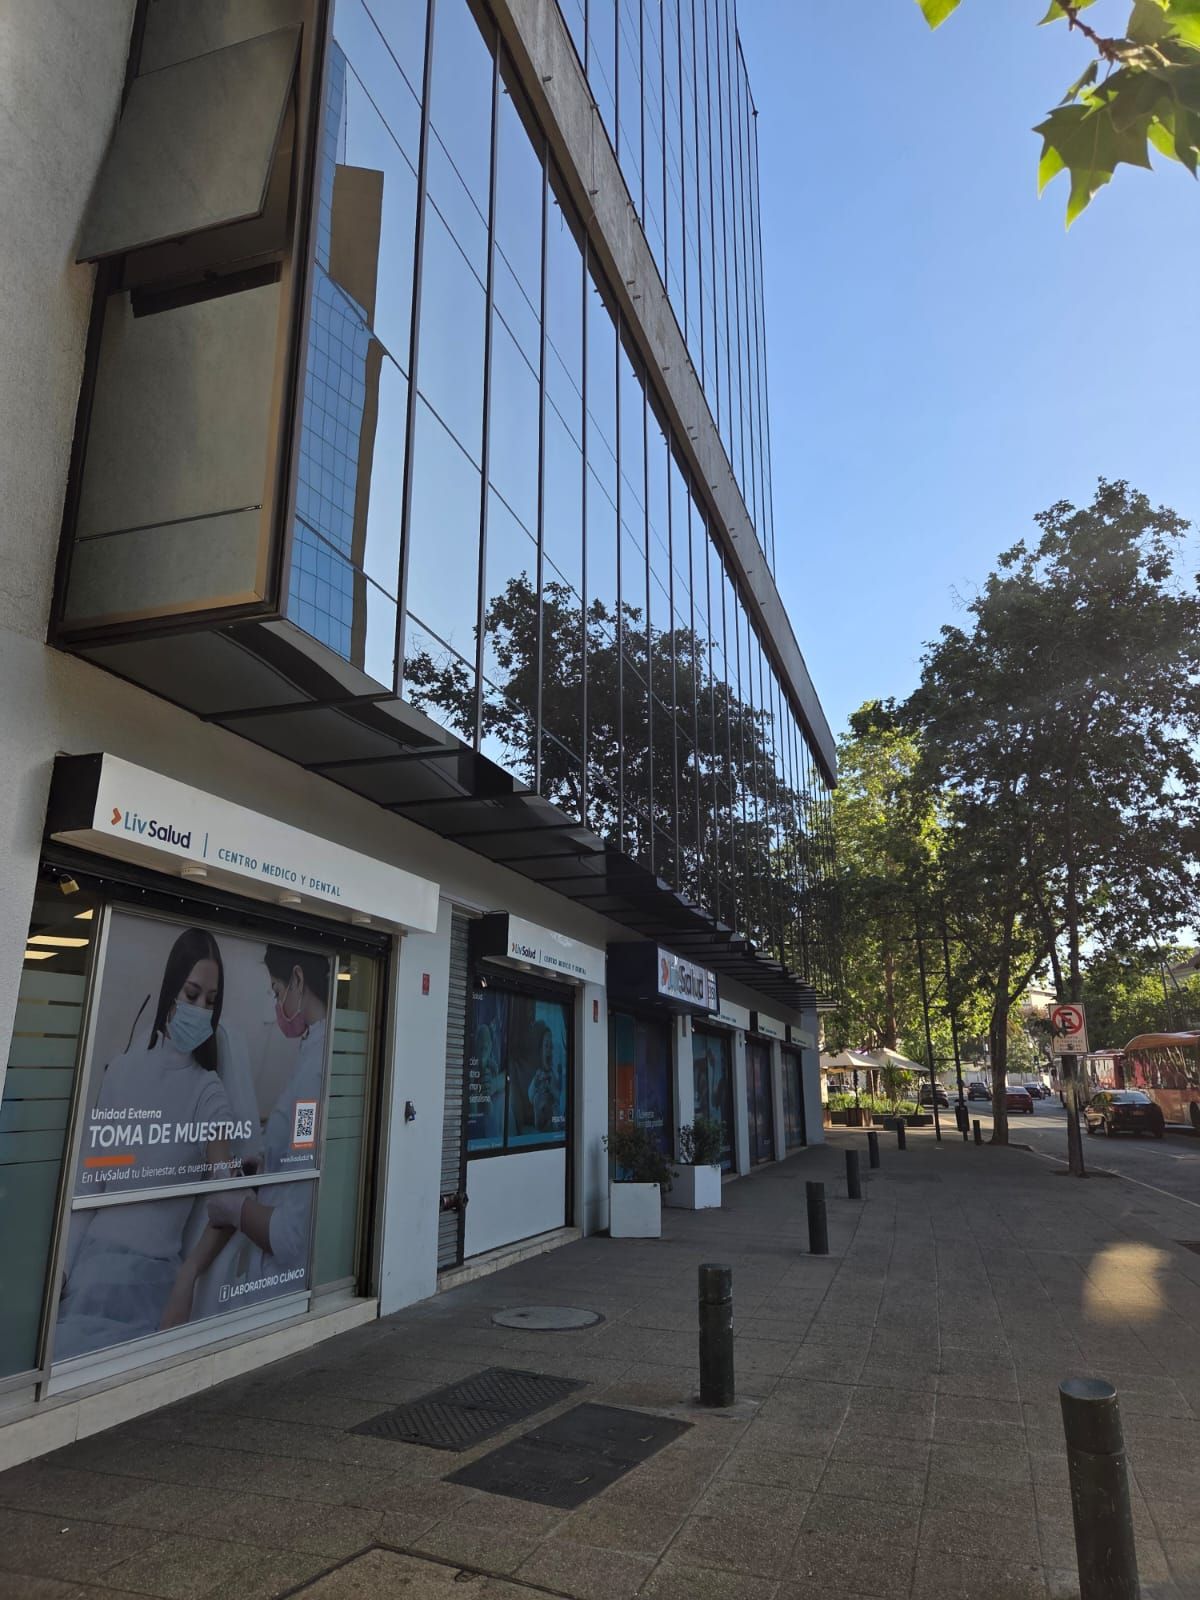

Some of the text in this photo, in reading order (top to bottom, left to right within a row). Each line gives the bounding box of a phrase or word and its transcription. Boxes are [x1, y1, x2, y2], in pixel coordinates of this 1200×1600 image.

[124, 811, 341, 897] LivSalud CENTRO MEDICO Y DENTAL
[91, 1108, 162, 1120] Unidad Externa
[89, 1120, 252, 1148] TOMA DE MUESTRAS
[82, 1171, 93, 1183] En
[95, 1167, 129, 1183] LivSalud
[131, 1169, 139, 1179] tu
[178, 1166, 186, 1175] es
[188, 1161, 212, 1173] nuestra
[230, 1275, 279, 1297] LABORATORIO
[280, 1268, 305, 1283] CLÍNICO
